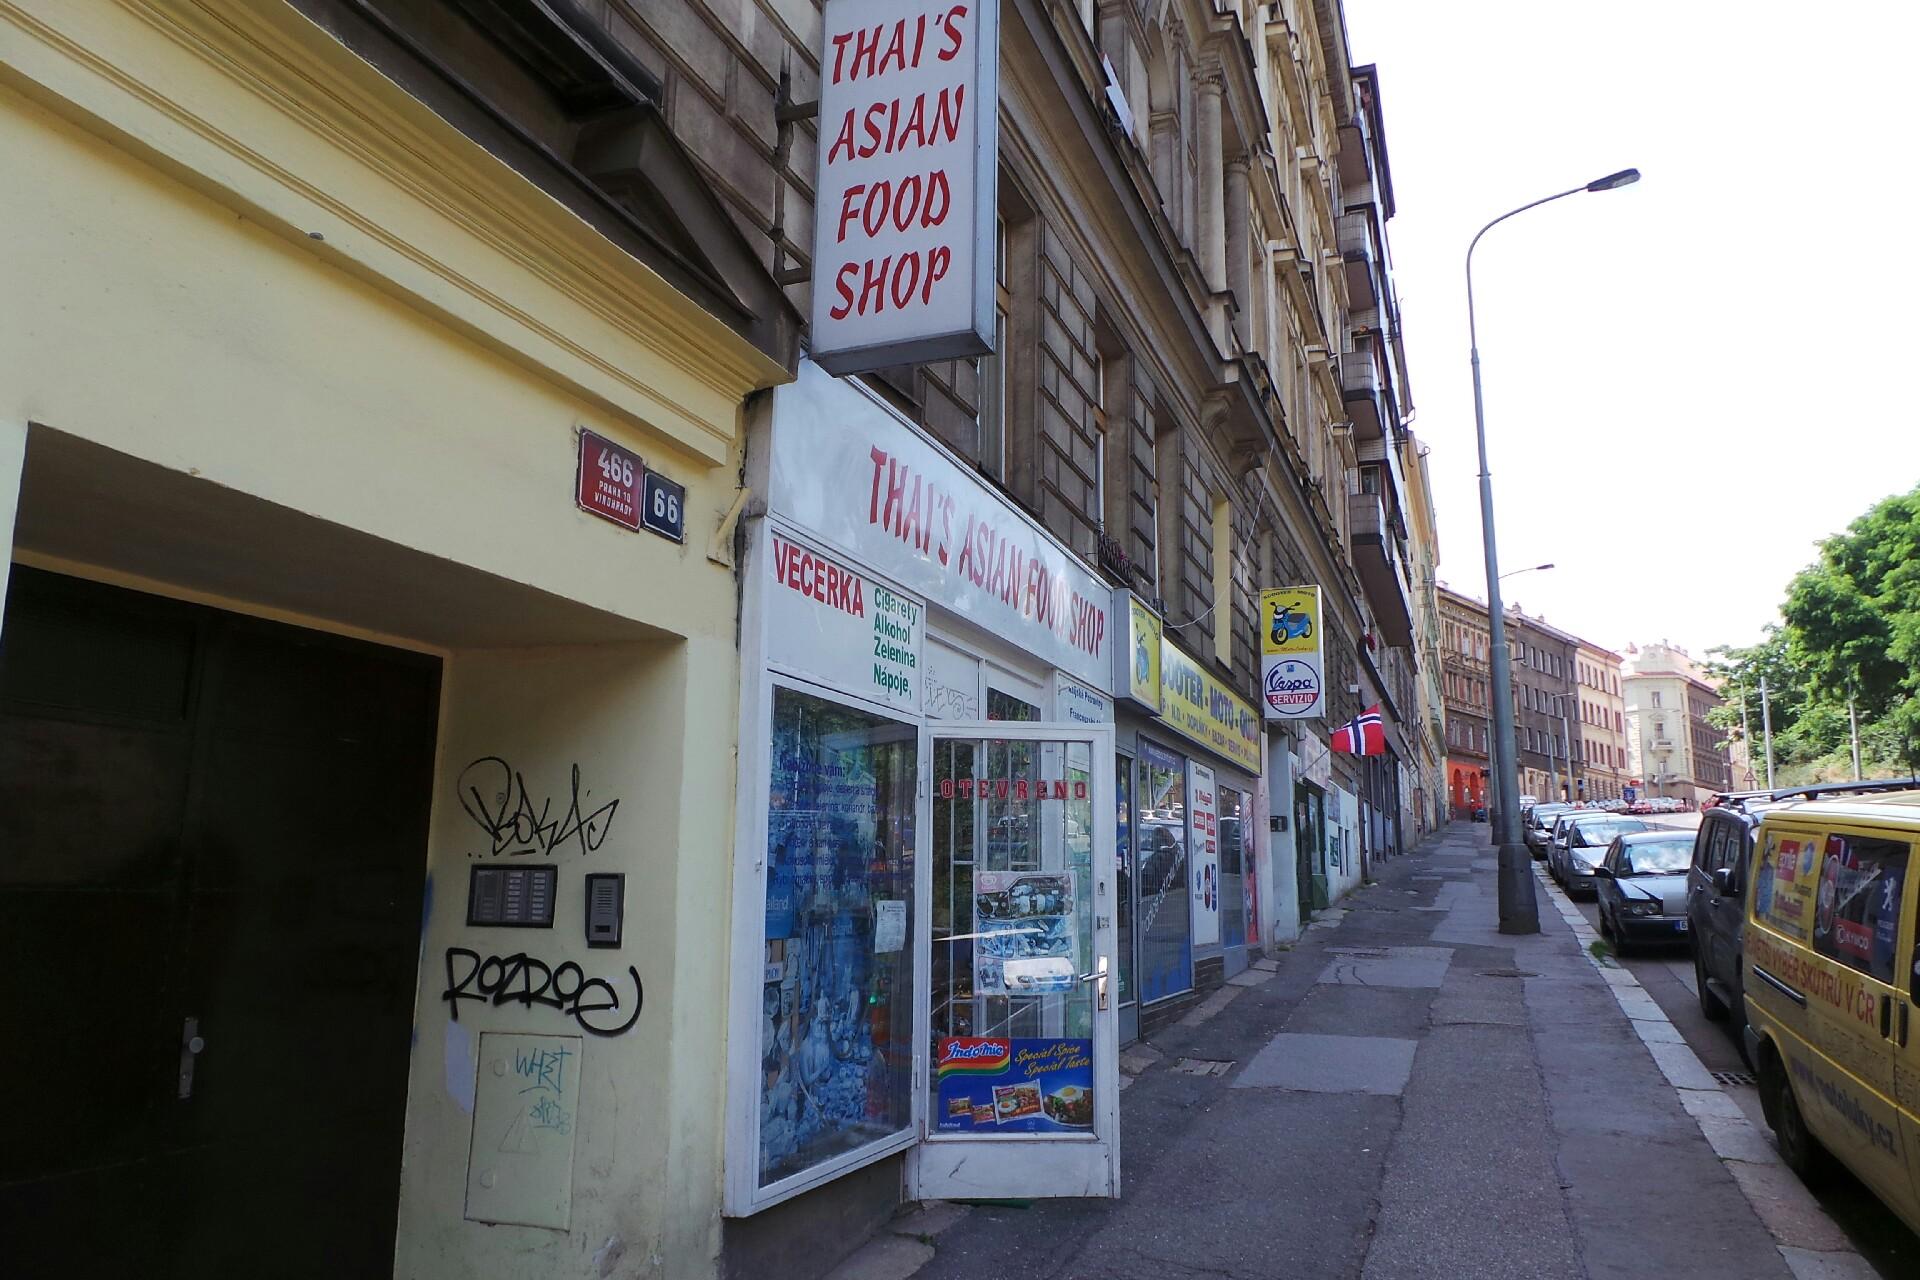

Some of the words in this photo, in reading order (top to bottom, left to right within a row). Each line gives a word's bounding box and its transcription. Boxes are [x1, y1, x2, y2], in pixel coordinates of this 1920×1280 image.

[832, 5, 968, 85] THAI'S
[828, 84, 964, 165] ASIAN
[837, 169, 950, 243] FOOD
[829, 245, 951, 320] SHOP
[598, 448, 633, 488] 466
[594, 492, 633, 517] VINOHRADY
[599, 480, 621, 499] PRAHA
[623, 492, 631, 502] 10
[654, 488, 678, 524] 66
[870, 444, 955, 566] THAI'S
[959, 513, 1023, 610] ASIAN
[1025, 558, 1070, 636] FOOD
[1069, 591, 1105, 660] SHOP
[773, 538, 864, 618] VECERKA
[874, 587, 917, 625] Cigarety
[874, 612, 911, 645] Alkohol
[874, 636, 916, 668] Zelenina
[1268, 669, 1315, 693] Vespa
[1272, 693, 1313, 704] SERVIZIO
[1210, 684, 1234, 731] MOTO
[1846, 984, 1855, 1014] V
[1856, 983, 1876, 1028] ČR
[1014, 1043, 1054, 1066] Special
[1053, 1042, 1081, 1060] Spice
[1024, 1060, 1062, 1078] Special
[1063, 1055, 1090, 1070] Taste
